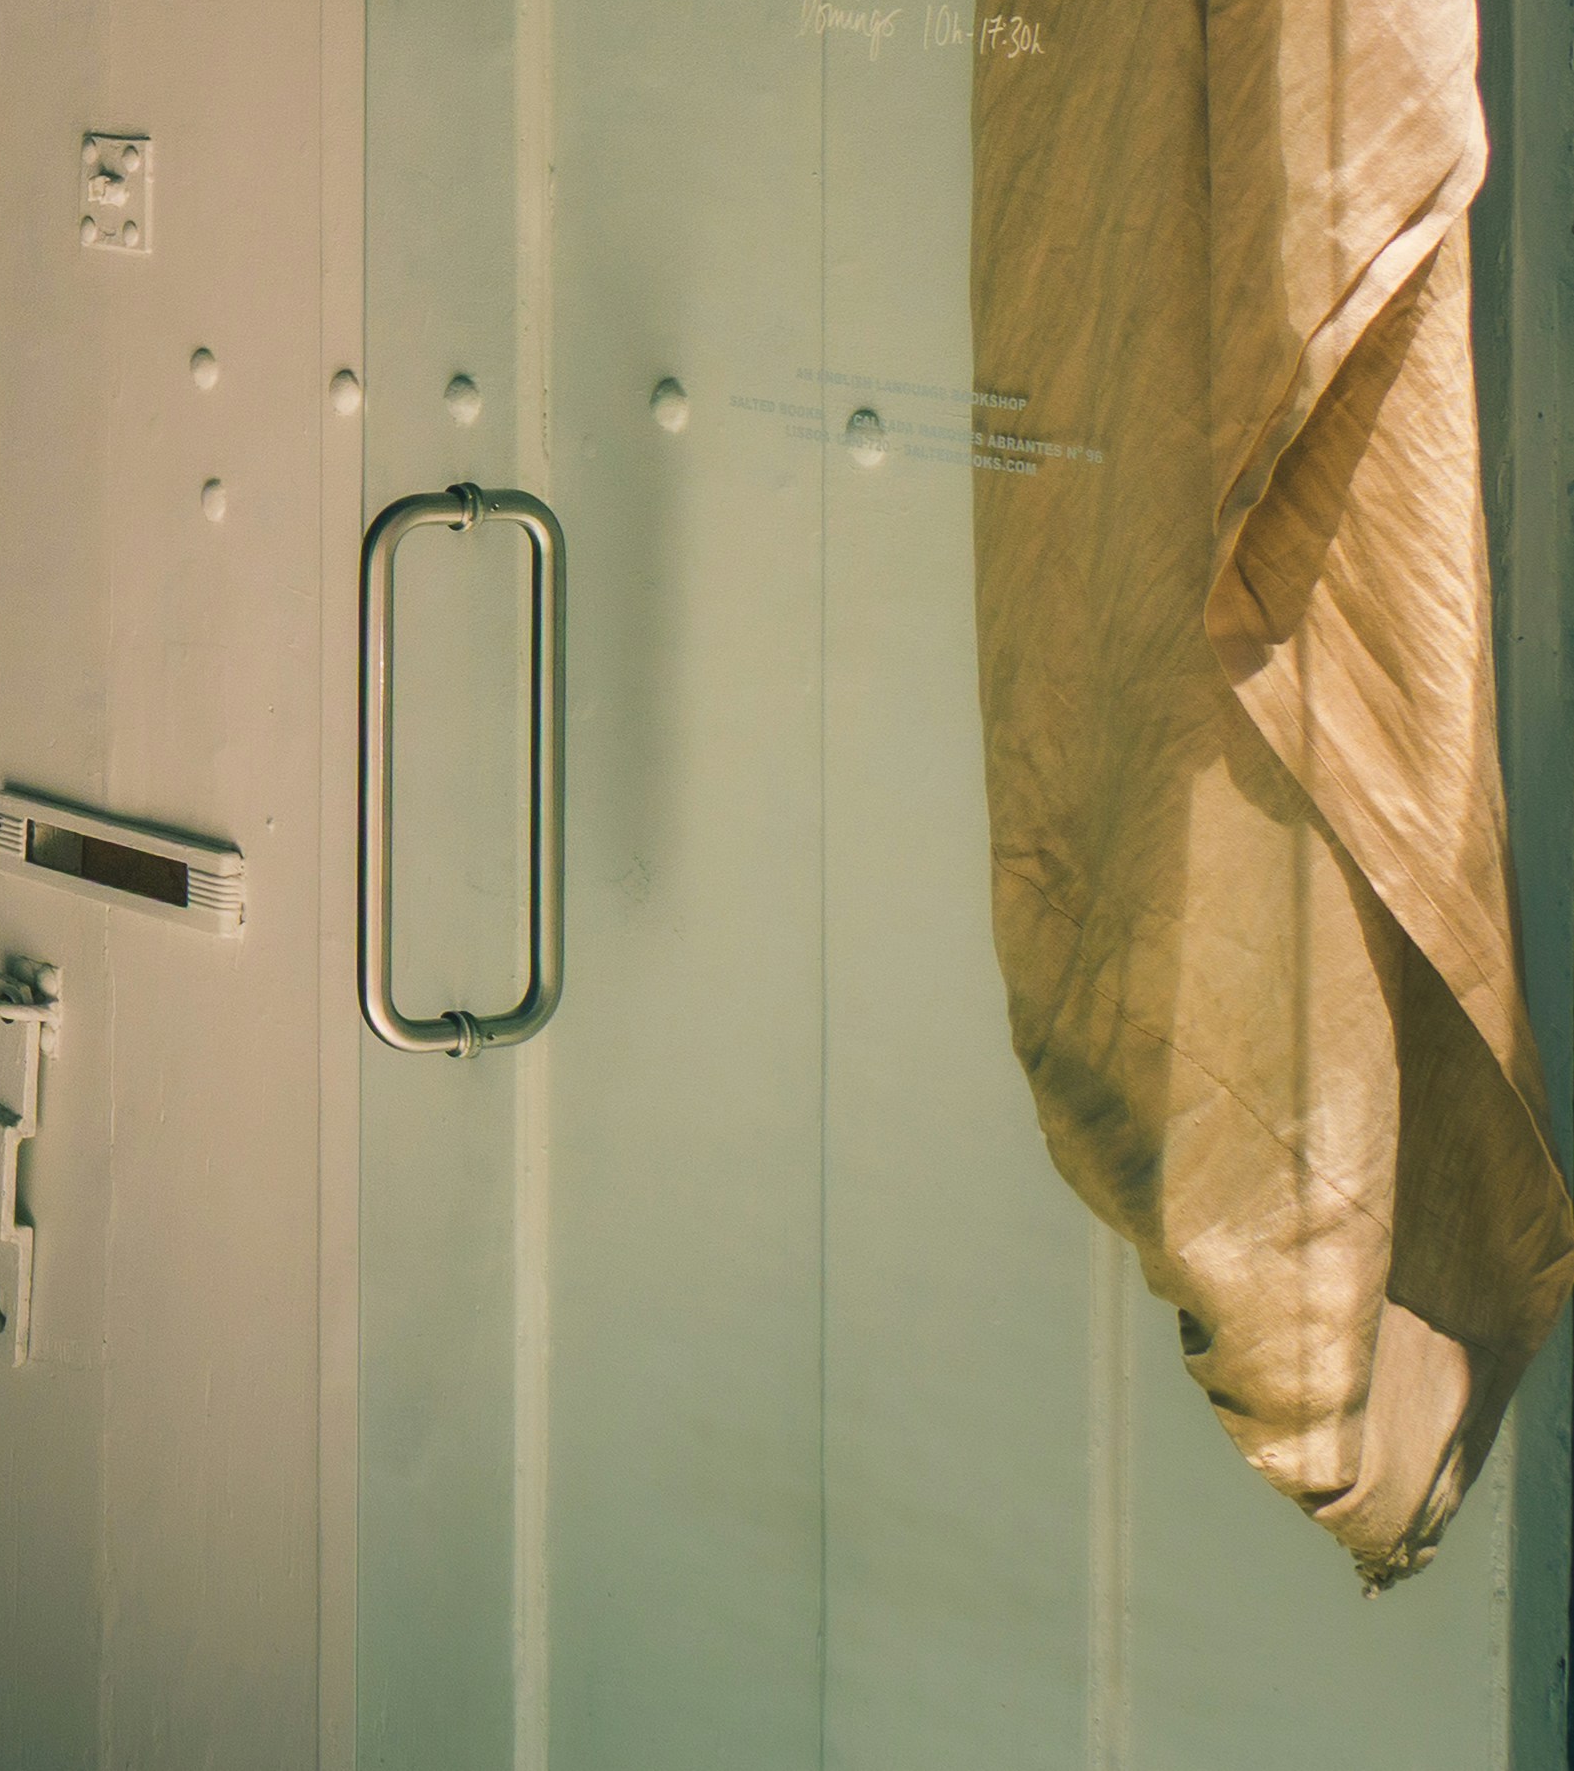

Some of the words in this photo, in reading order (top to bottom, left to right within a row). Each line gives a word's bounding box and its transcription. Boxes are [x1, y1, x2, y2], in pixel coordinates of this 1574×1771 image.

[728, 394, 776, 414] SALTED
[951, 388, 1029, 412] BOOKSHOP
[987, 435, 1062, 459] ABRANTES
[1085, 448, 1104, 465] 96
